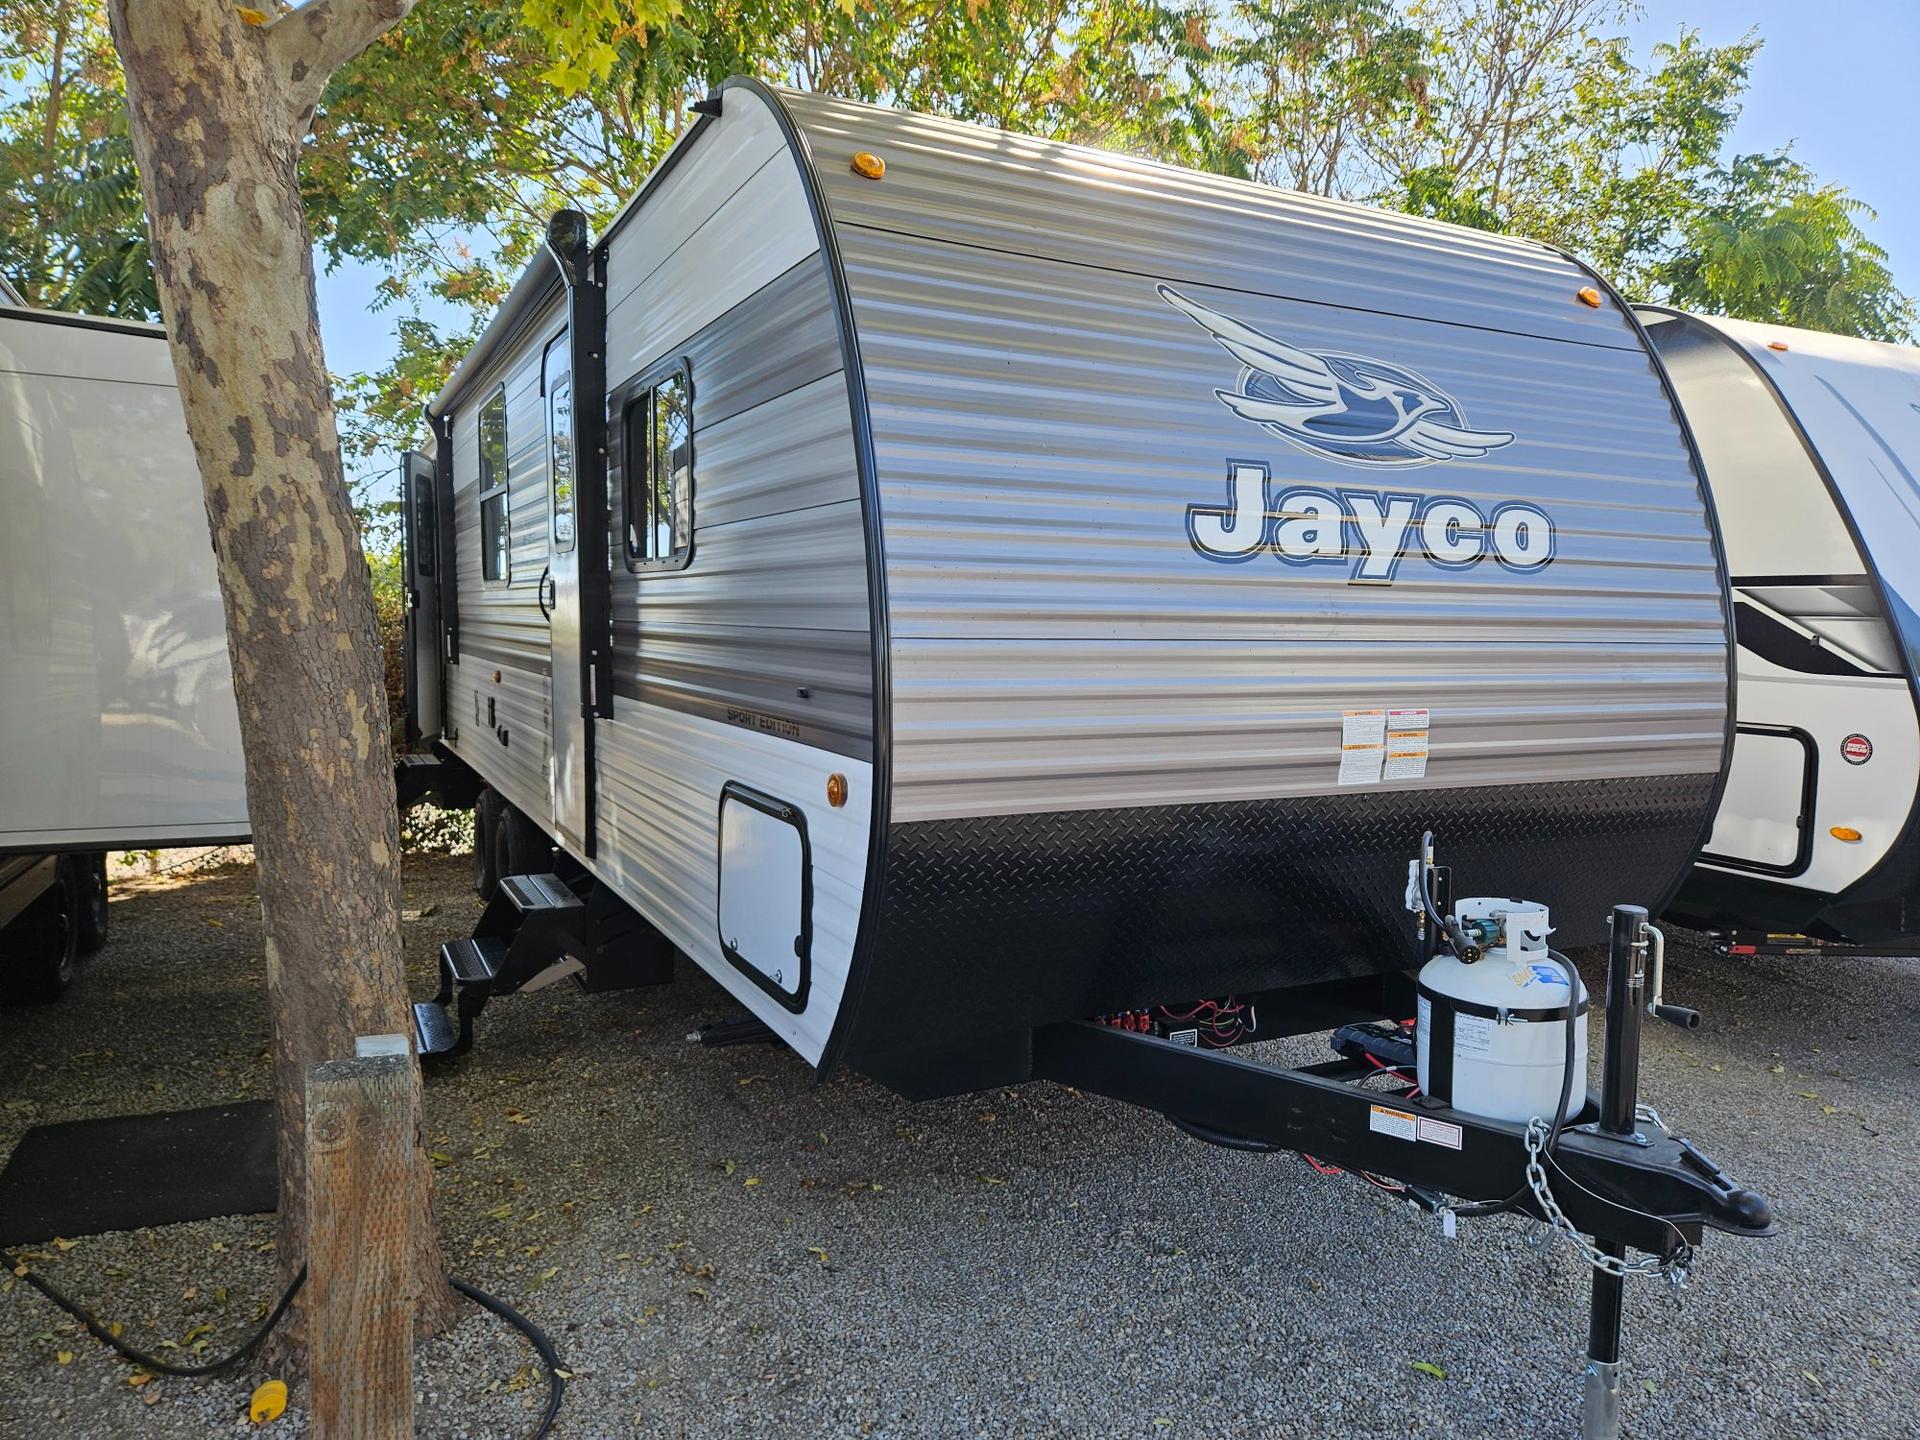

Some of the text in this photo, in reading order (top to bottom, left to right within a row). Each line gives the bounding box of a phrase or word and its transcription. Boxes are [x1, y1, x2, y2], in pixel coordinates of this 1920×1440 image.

[1186, 458, 1557, 585] Jayco
[727, 708, 800, 737] SPORT EDITION
